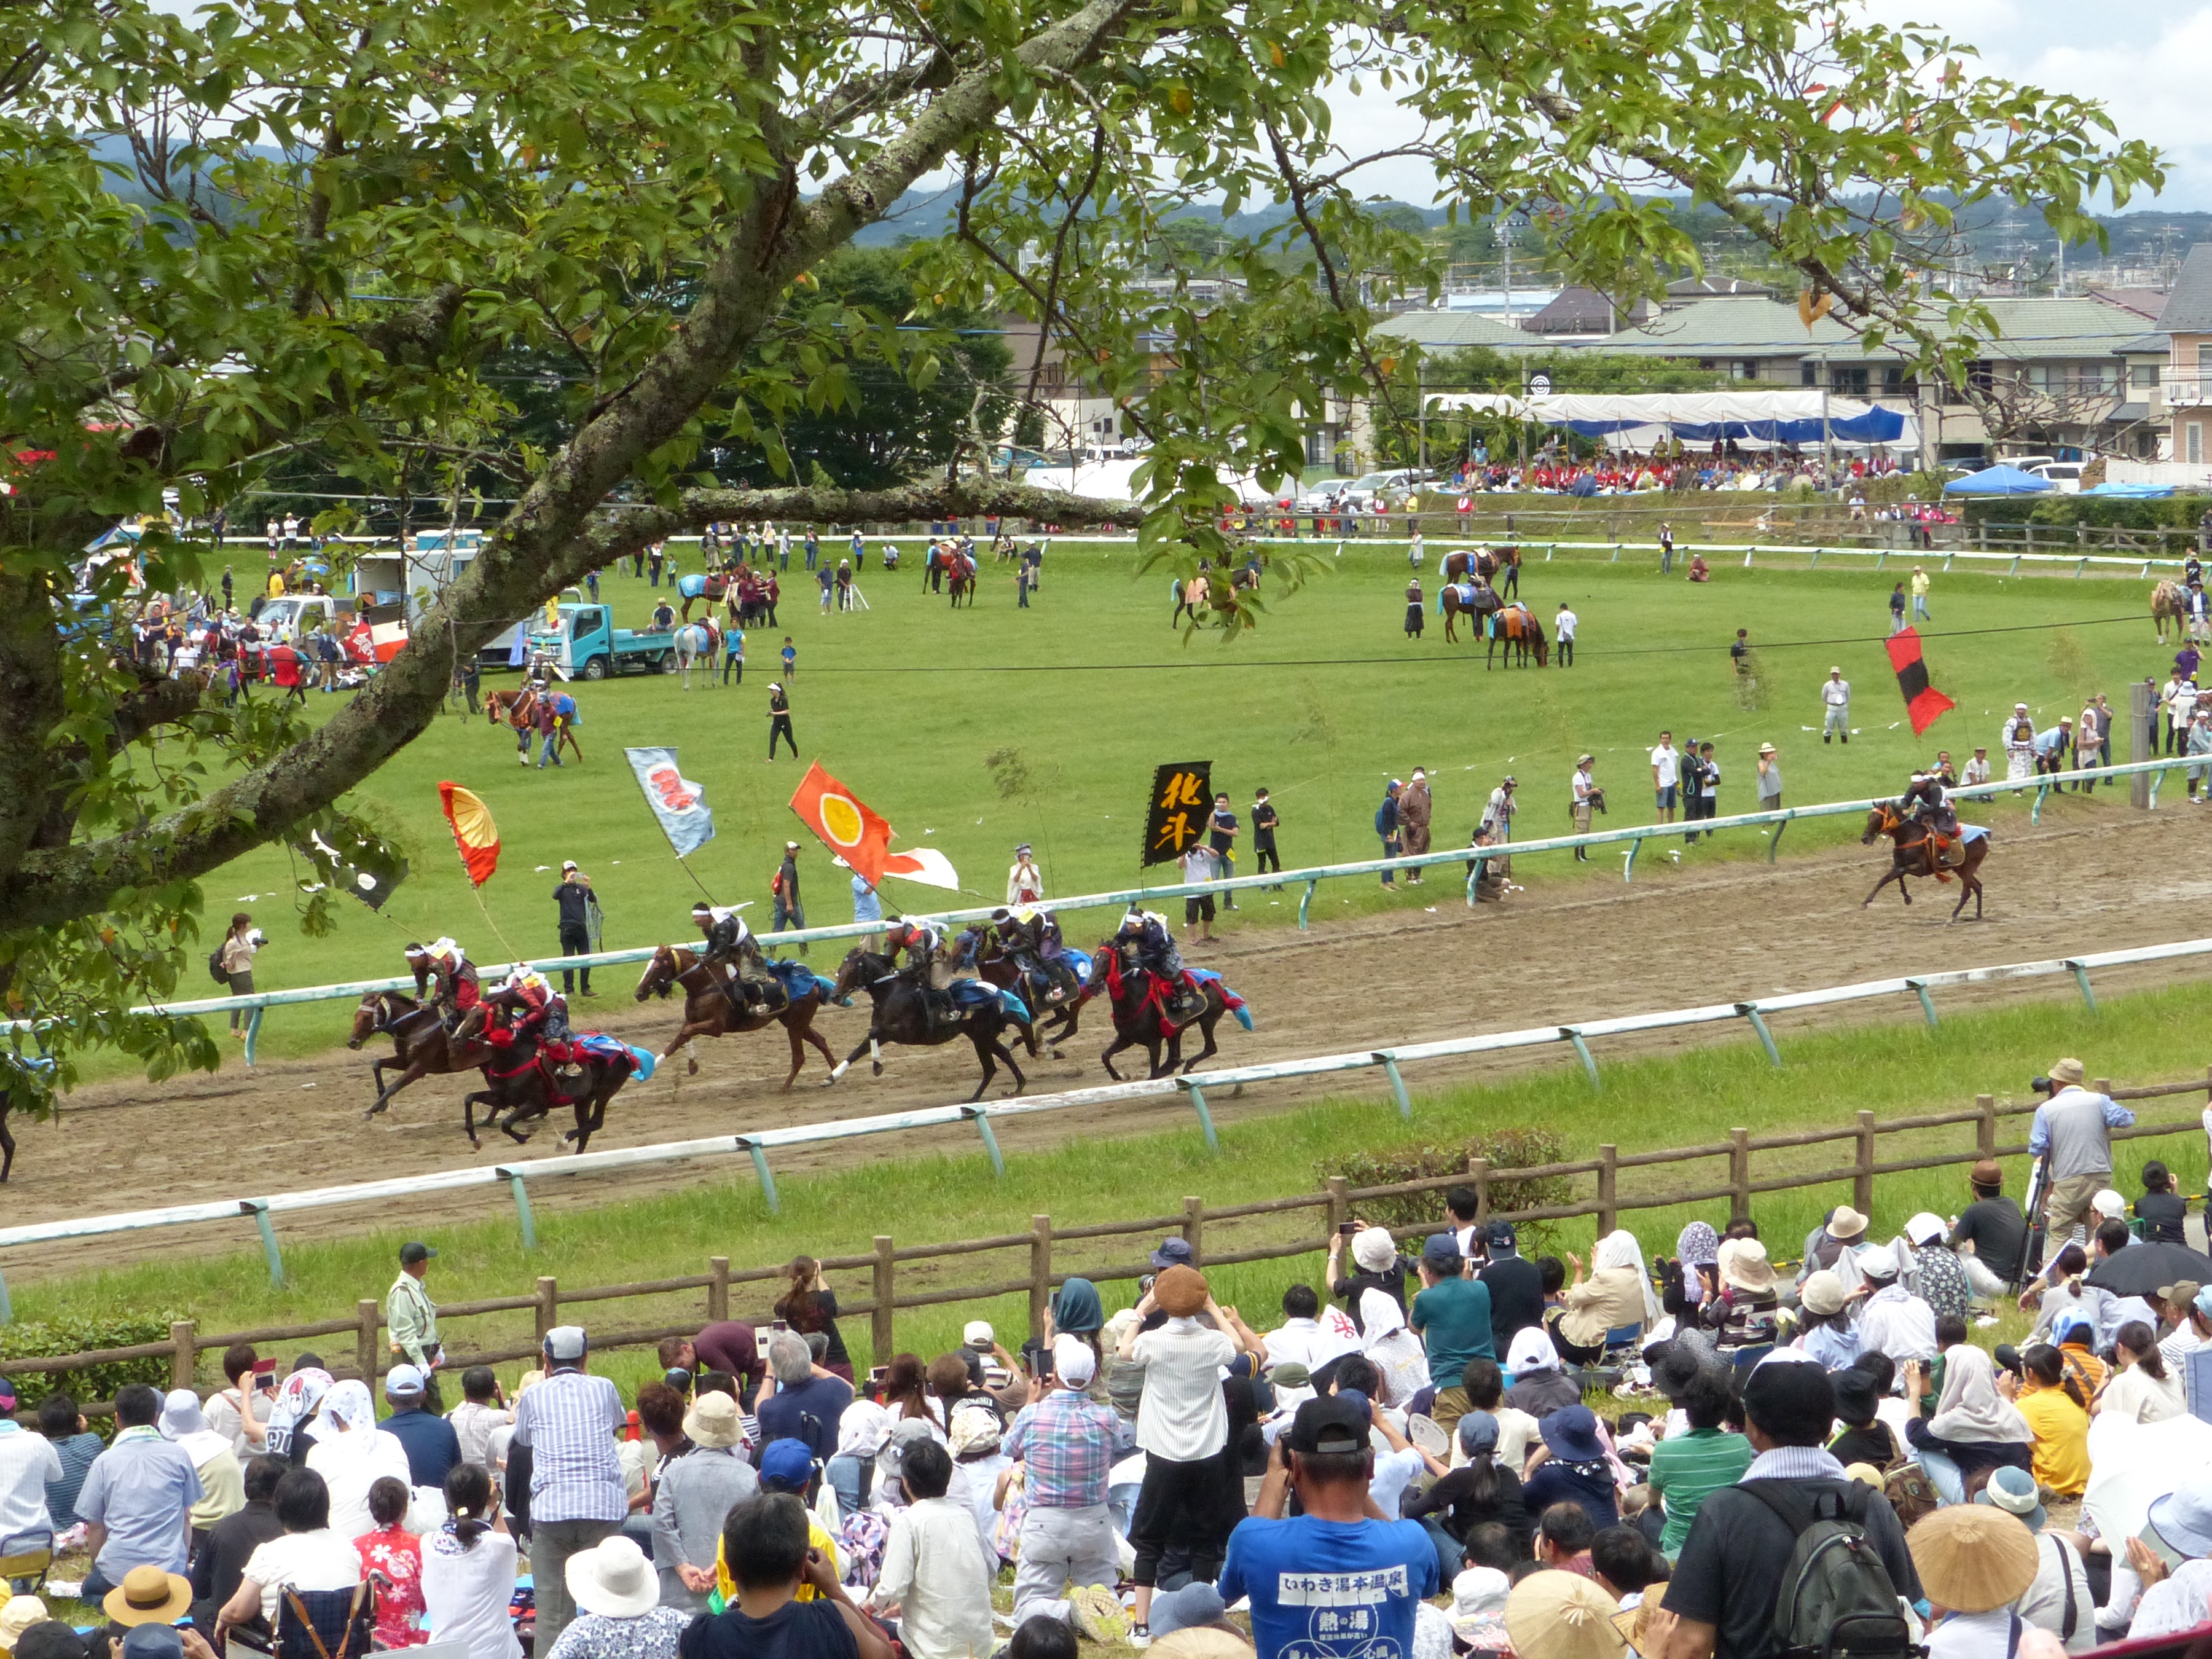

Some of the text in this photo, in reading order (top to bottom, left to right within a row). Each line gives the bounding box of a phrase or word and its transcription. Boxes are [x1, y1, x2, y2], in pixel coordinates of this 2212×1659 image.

[1154, 772, 1202, 852] 北斗
[1284, 1571, 1402, 1592] いわき湯本温泉
[1319, 1610, 1369, 1631] 熱の湯
